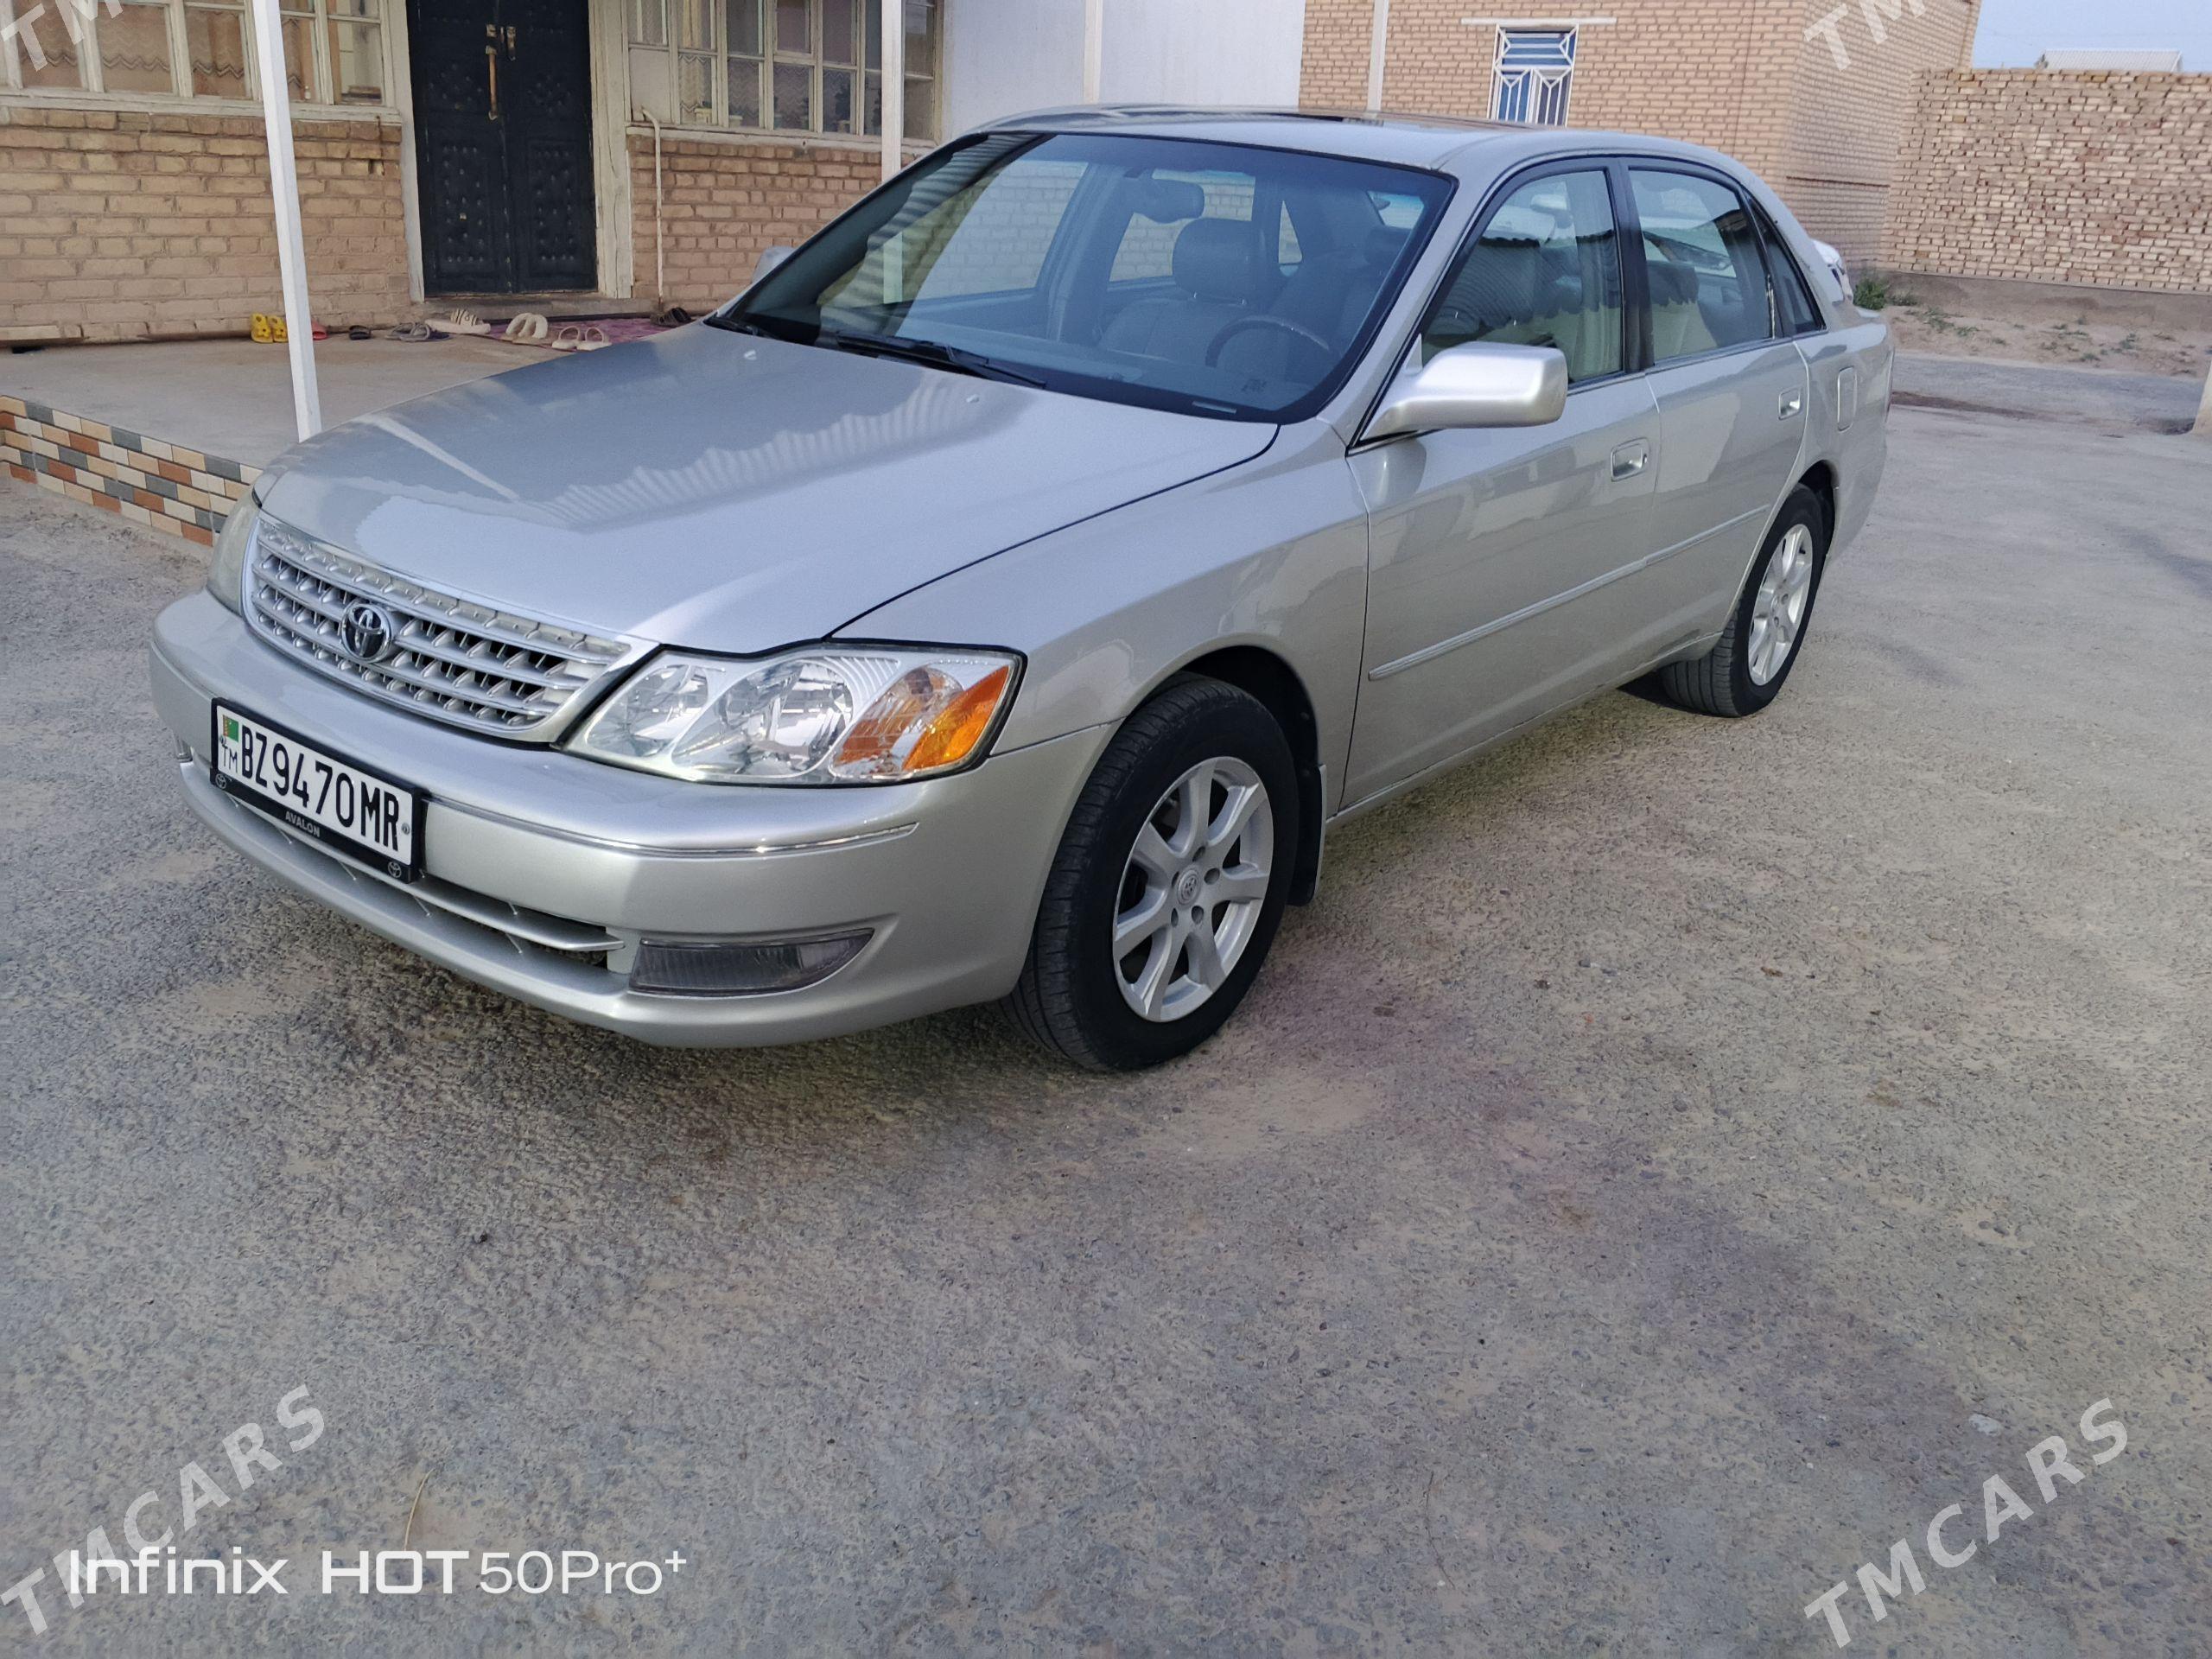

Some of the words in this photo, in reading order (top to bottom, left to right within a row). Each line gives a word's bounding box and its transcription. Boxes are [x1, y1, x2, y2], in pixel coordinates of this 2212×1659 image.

[221, 744, 238, 773] TM
[241, 724, 400, 851] BZ9470MR
[285, 810, 321, 838] AVALON
